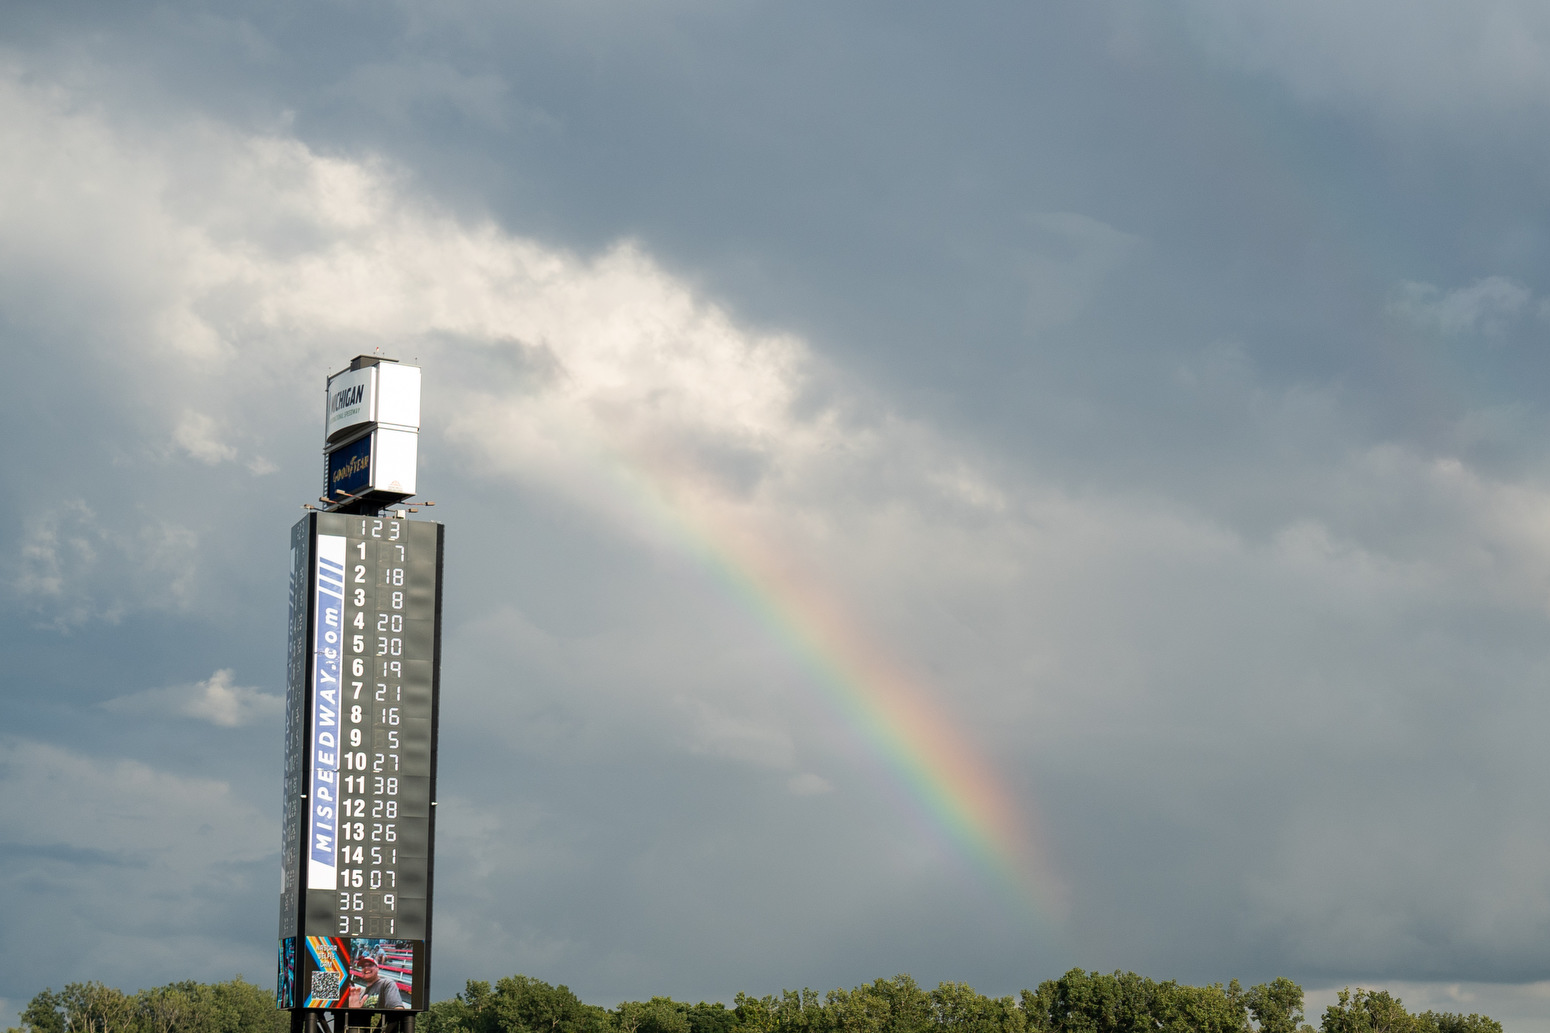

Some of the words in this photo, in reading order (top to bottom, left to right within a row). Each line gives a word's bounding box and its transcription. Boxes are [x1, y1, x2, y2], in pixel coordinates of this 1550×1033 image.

[333, 455, 369, 483] GOODYEAR
[357, 542, 366, 560] 1
[395, 545, 405, 562] 7
[354, 565, 366, 583] 2
[386, 568, 404, 586] 18
[354, 588, 366, 607] 3
[392, 591, 403, 609] 8
[353, 612, 365, 630] 4
[377, 613, 402, 632] 20
[353, 635, 364, 653] 5
[378, 637, 402, 656] 30
[352, 658, 364, 676] 6
[384, 661, 401, 678] 19
[352, 682, 363, 700] 7
[375, 683, 400, 702] 21
[350, 705, 362, 723] 8
[382, 707, 400, 725] 16
[316, 607, 338, 853] MISPEEDWAY.com
[350, 728, 362, 747] 9
[388, 731, 399, 749] 5
[344, 752, 367, 771] 10
[373, 753, 399, 771] 27
[344, 775, 365, 794] 11
[374, 776, 398, 795] 38
[342, 799, 366, 818] 12
[372, 800, 398, 819] 28
[342, 822, 365, 841] 13
[371, 823, 396, 842] 26
[341, 846, 364, 864] 14
[371, 847, 396, 865] 51
[341, 869, 364, 888] 15
[370, 870, 396, 888] 07
[339, 892, 364, 911] 36
[384, 894, 395, 911] 9
[339, 916, 364, 934] 37
